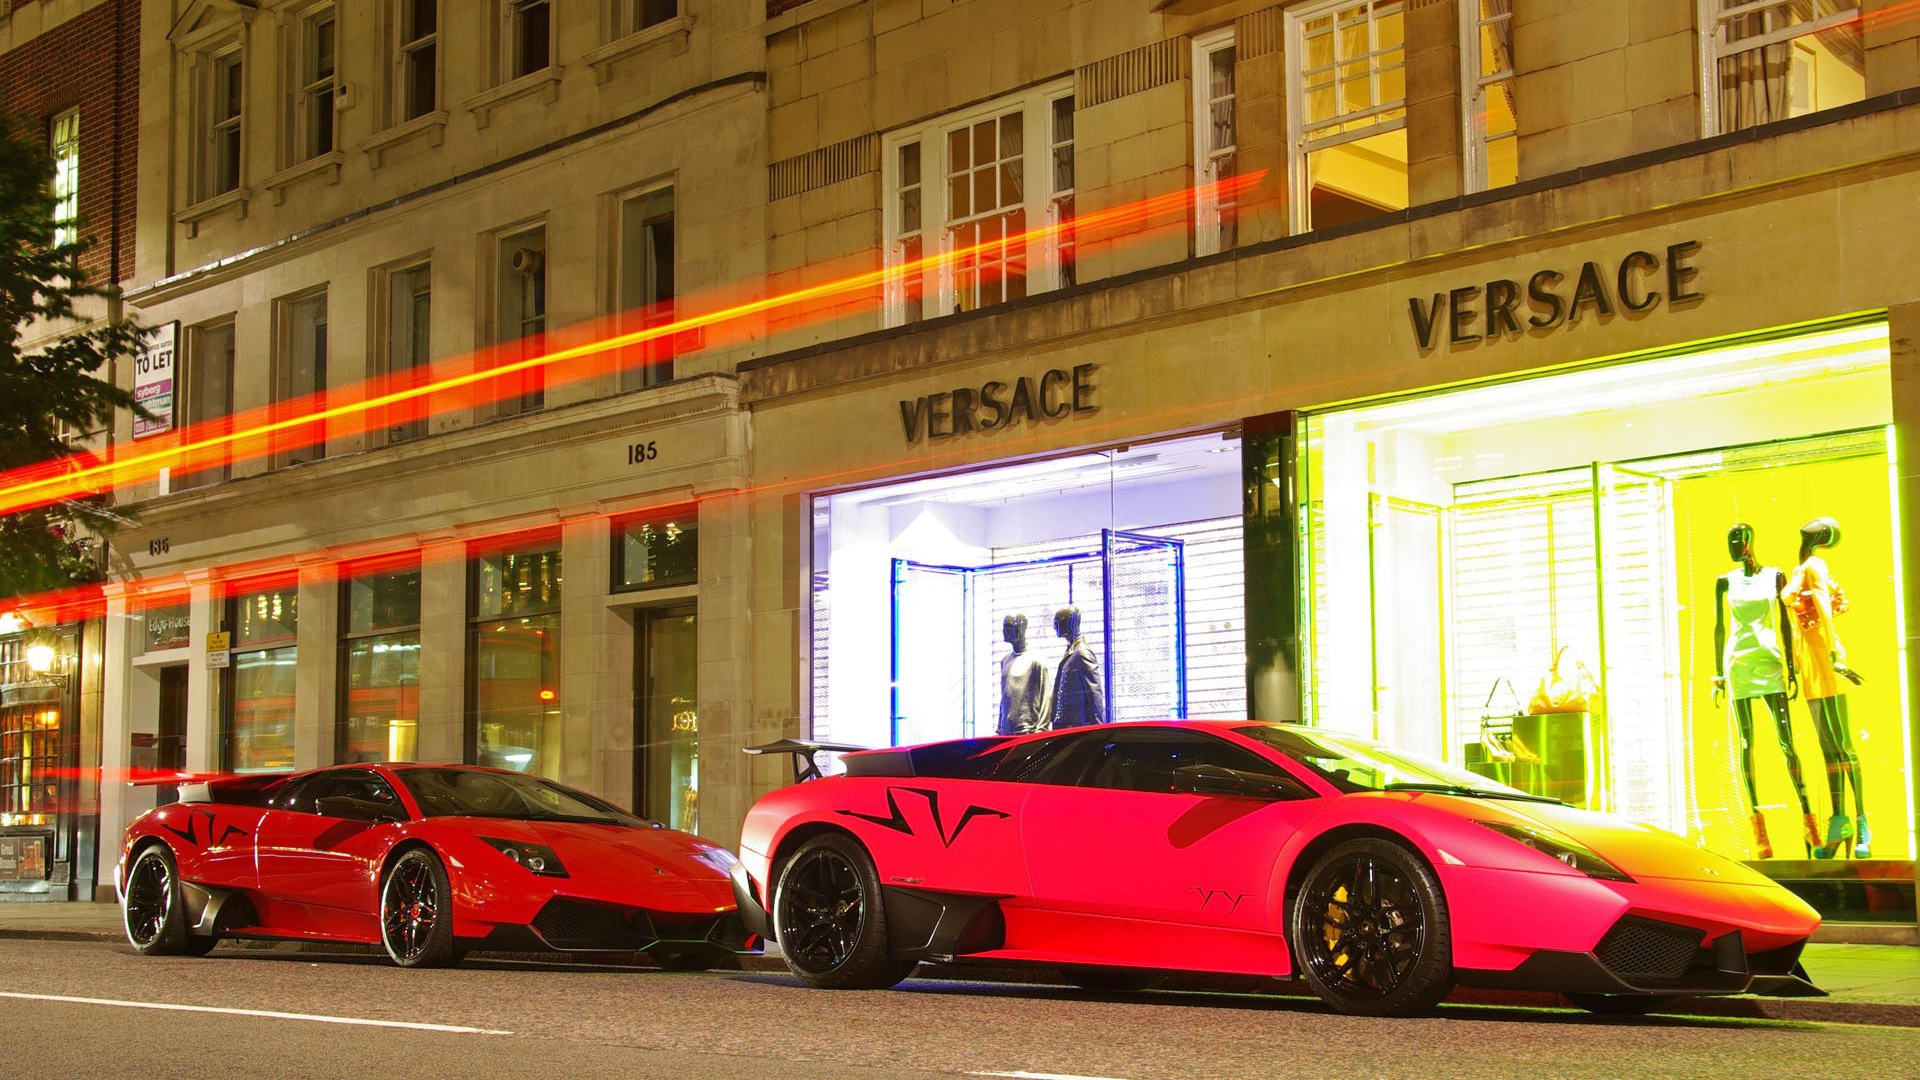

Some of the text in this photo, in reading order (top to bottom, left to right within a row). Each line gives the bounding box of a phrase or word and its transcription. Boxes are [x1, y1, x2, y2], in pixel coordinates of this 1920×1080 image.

[1408, 240, 1704, 351] VERSACE
[136, 349, 172, 375] TO LET
[899, 362, 1100, 444] VERSACE
[628, 440, 658, 465] 185
[149, 536, 170, 557] 186
